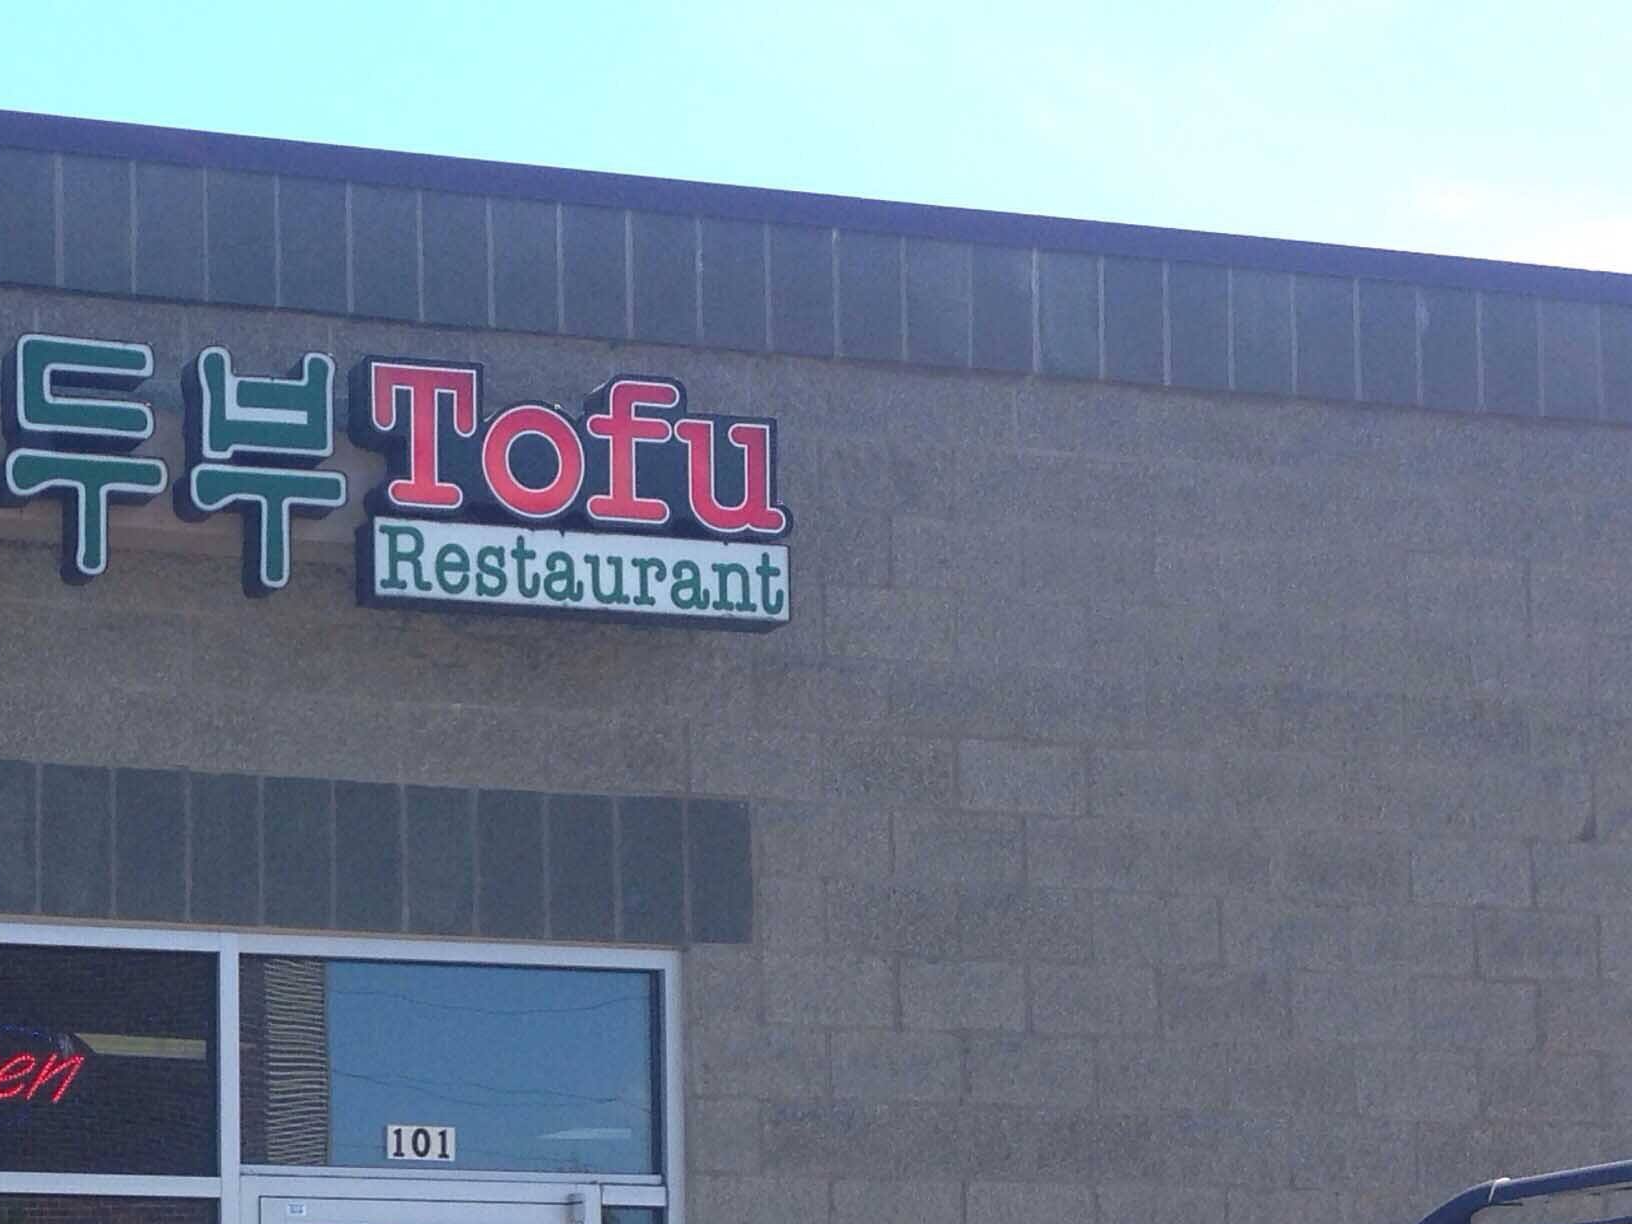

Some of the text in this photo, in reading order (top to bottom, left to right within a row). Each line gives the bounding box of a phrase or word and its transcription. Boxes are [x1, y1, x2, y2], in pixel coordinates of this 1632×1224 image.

[370, 361, 787, 535] Tofu
[377, 524, 784, 617] Restaurant
[391, 1127, 451, 1159] 101
